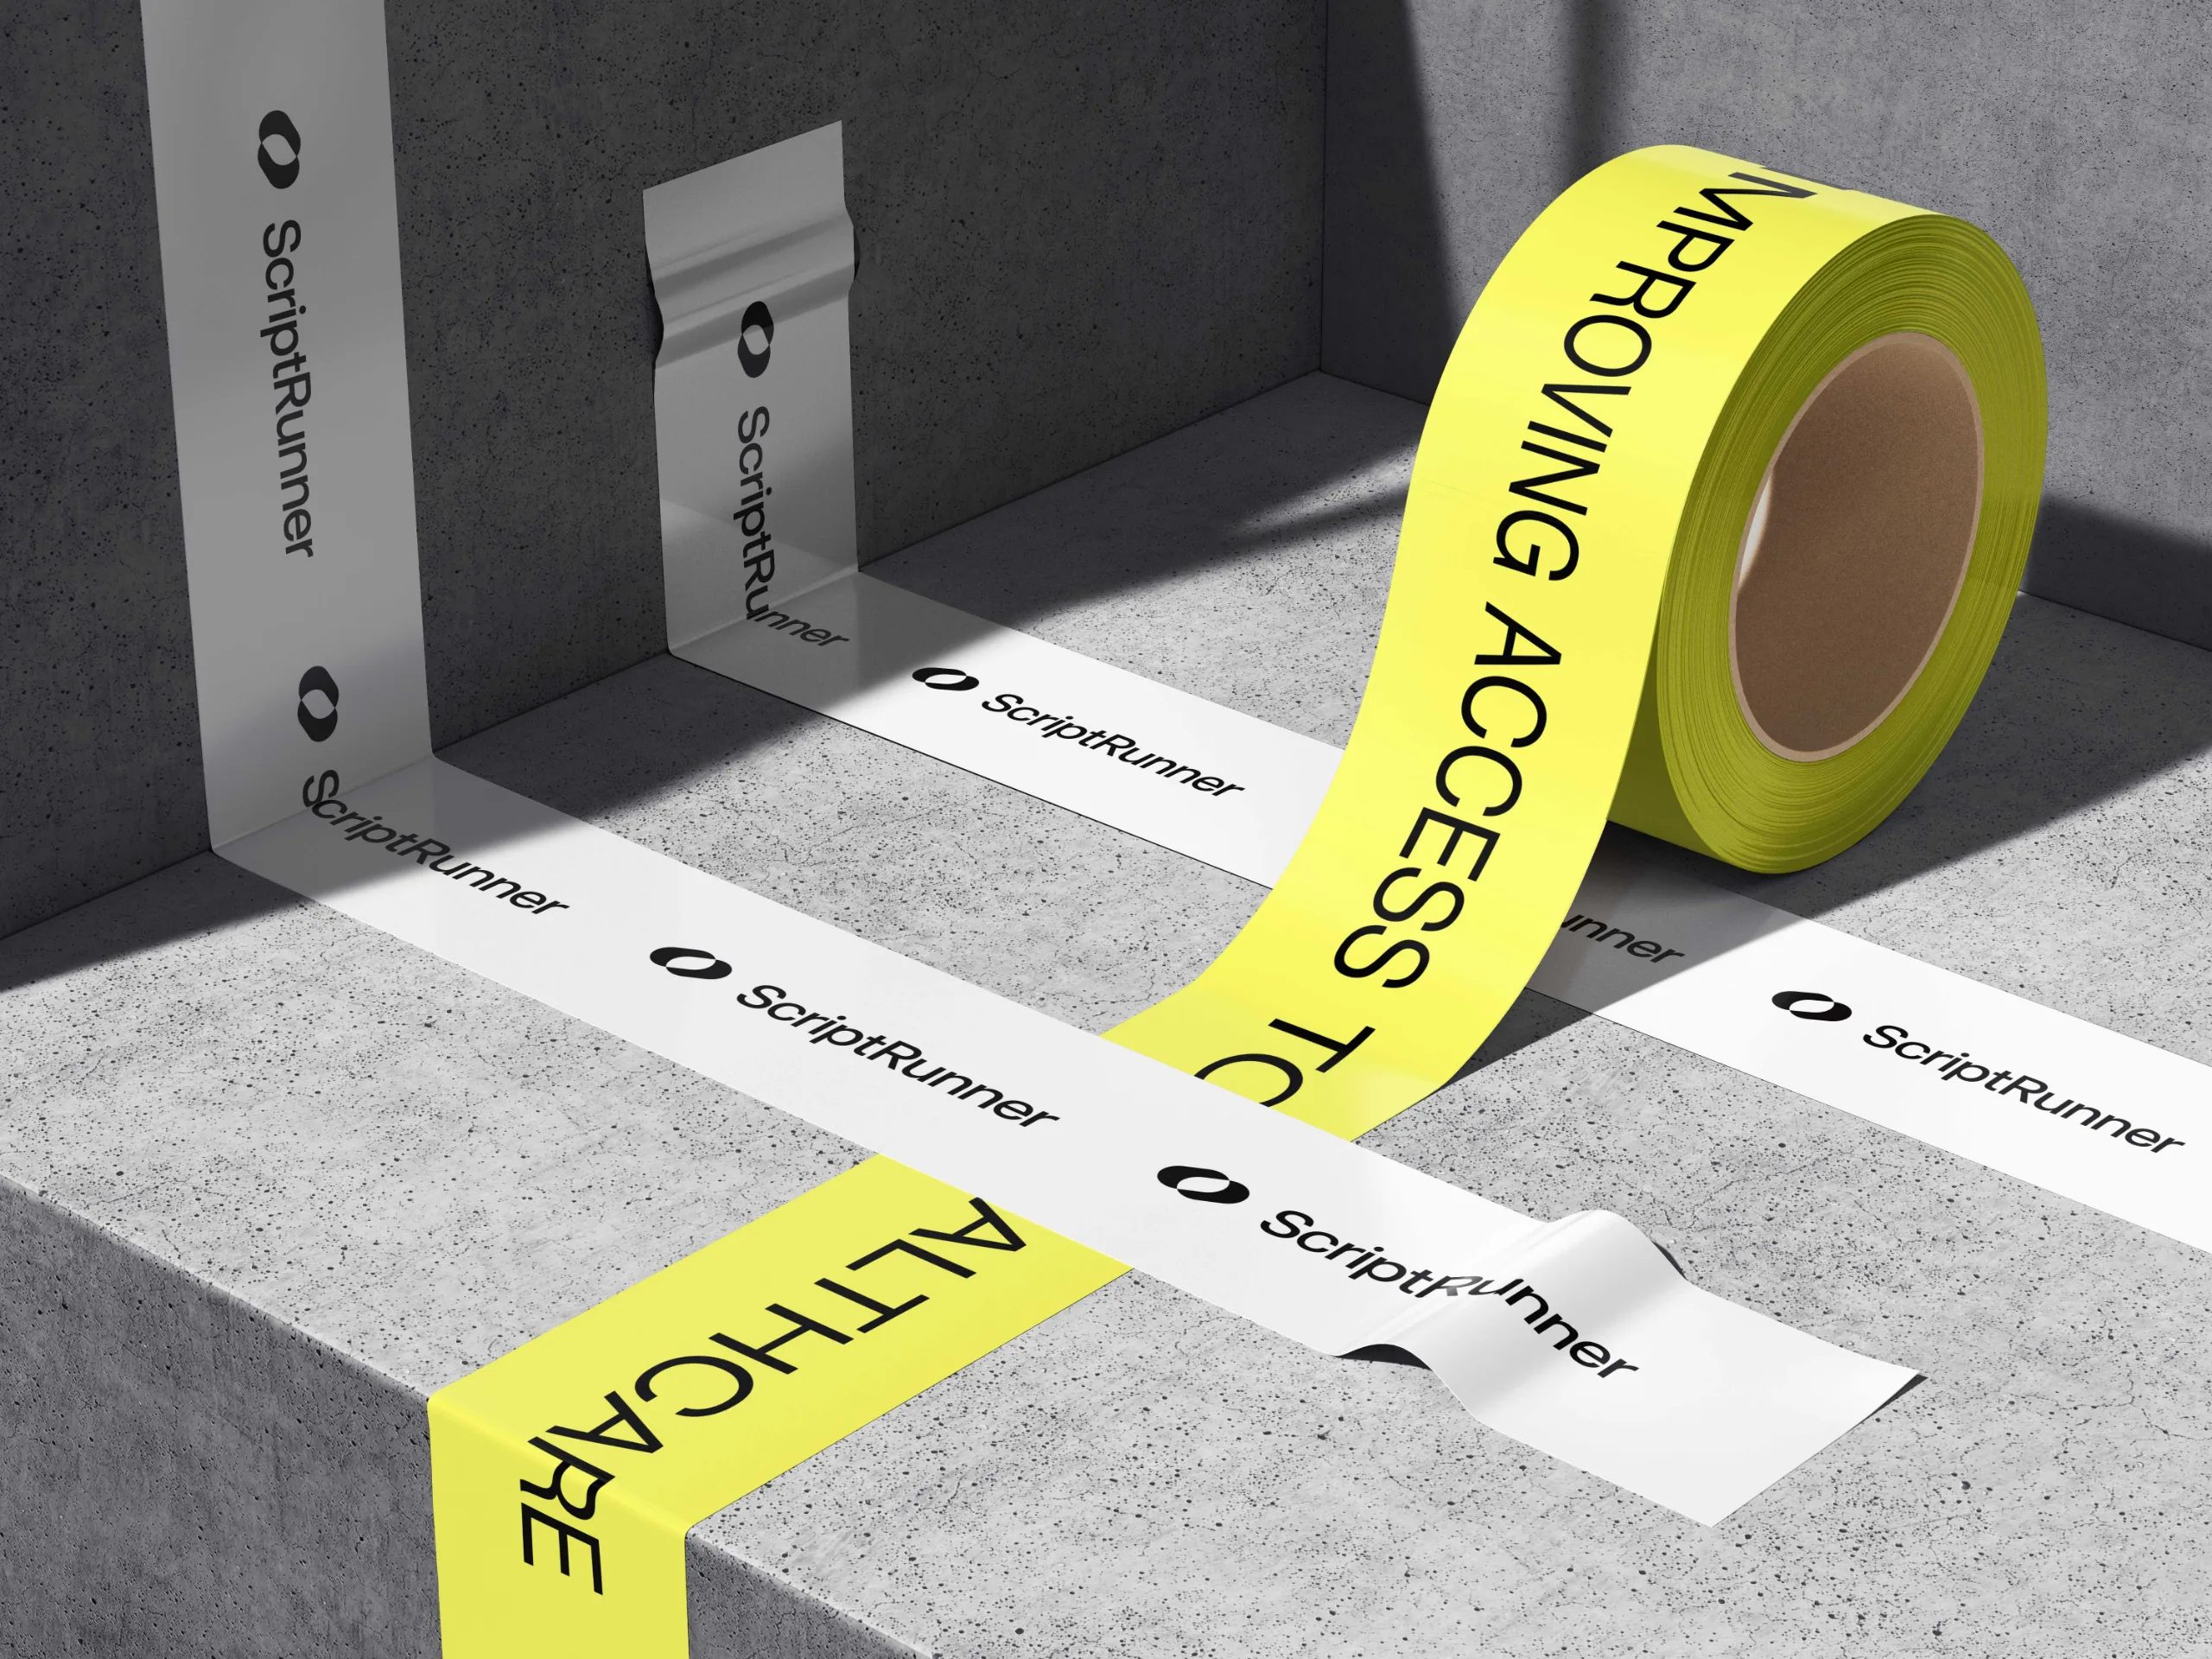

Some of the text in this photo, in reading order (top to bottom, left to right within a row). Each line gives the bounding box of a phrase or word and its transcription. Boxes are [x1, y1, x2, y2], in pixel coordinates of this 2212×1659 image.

[259, 219, 314, 558] ScriptRunner
[733, 406, 850, 649] ScriptRunner
[981, 693, 1245, 801] ScriptRunner
[1333, 601, 1562, 989] ACCESS
[302, 769, 569, 916] ScriptRunner
[736, 984, 1061, 1128] ScriptRunner
[1862, 1025, 2186, 1154] ScriptRunner
[1260, 1210, 1640, 1379] ScriptRunner
[519, 1197, 1027, 1596] ALTHCARE
